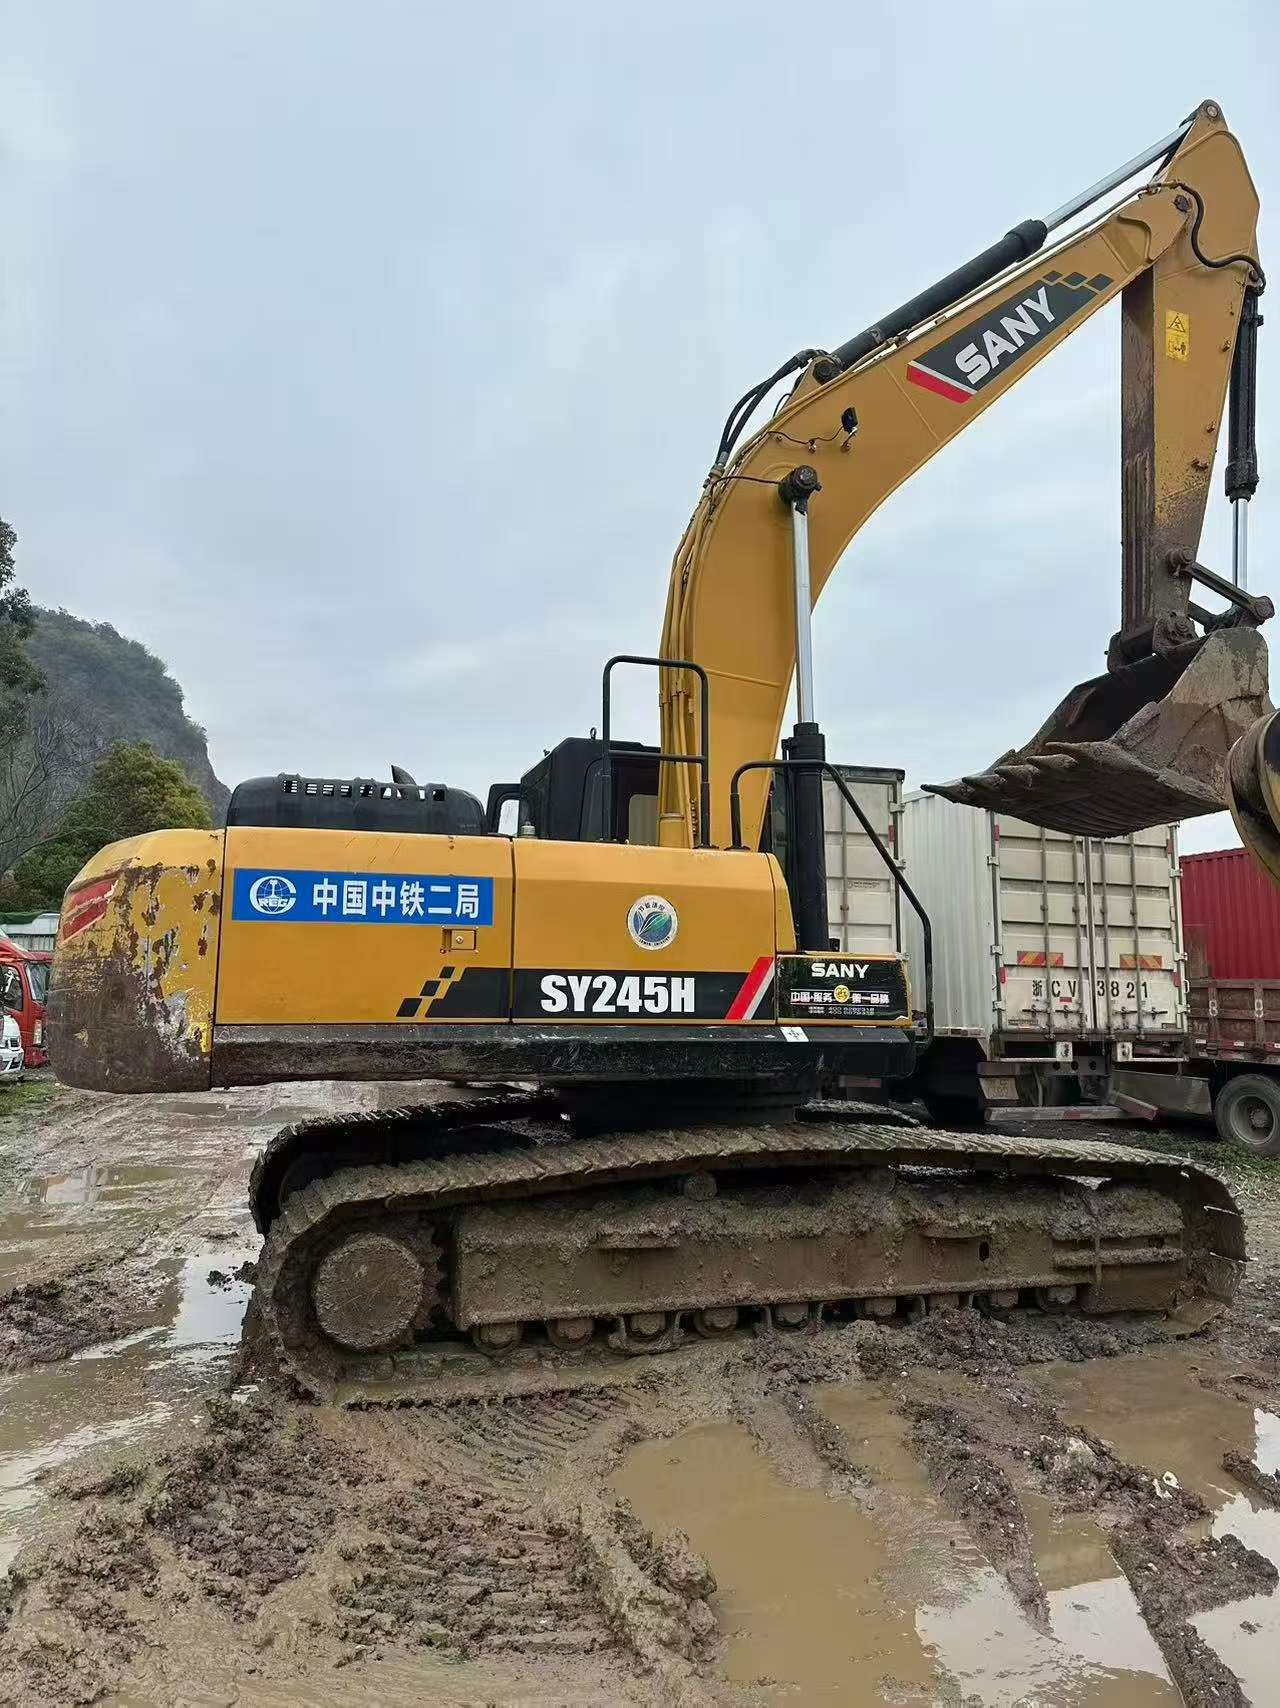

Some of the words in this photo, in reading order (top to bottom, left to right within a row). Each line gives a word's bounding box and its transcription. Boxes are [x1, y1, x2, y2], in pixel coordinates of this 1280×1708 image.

[955, 286, 1056, 385] SANY
[312, 877, 480, 919] 中国中铁二局
[811, 962, 870, 979] SANY
[540, 974, 695, 1014] SY245H
